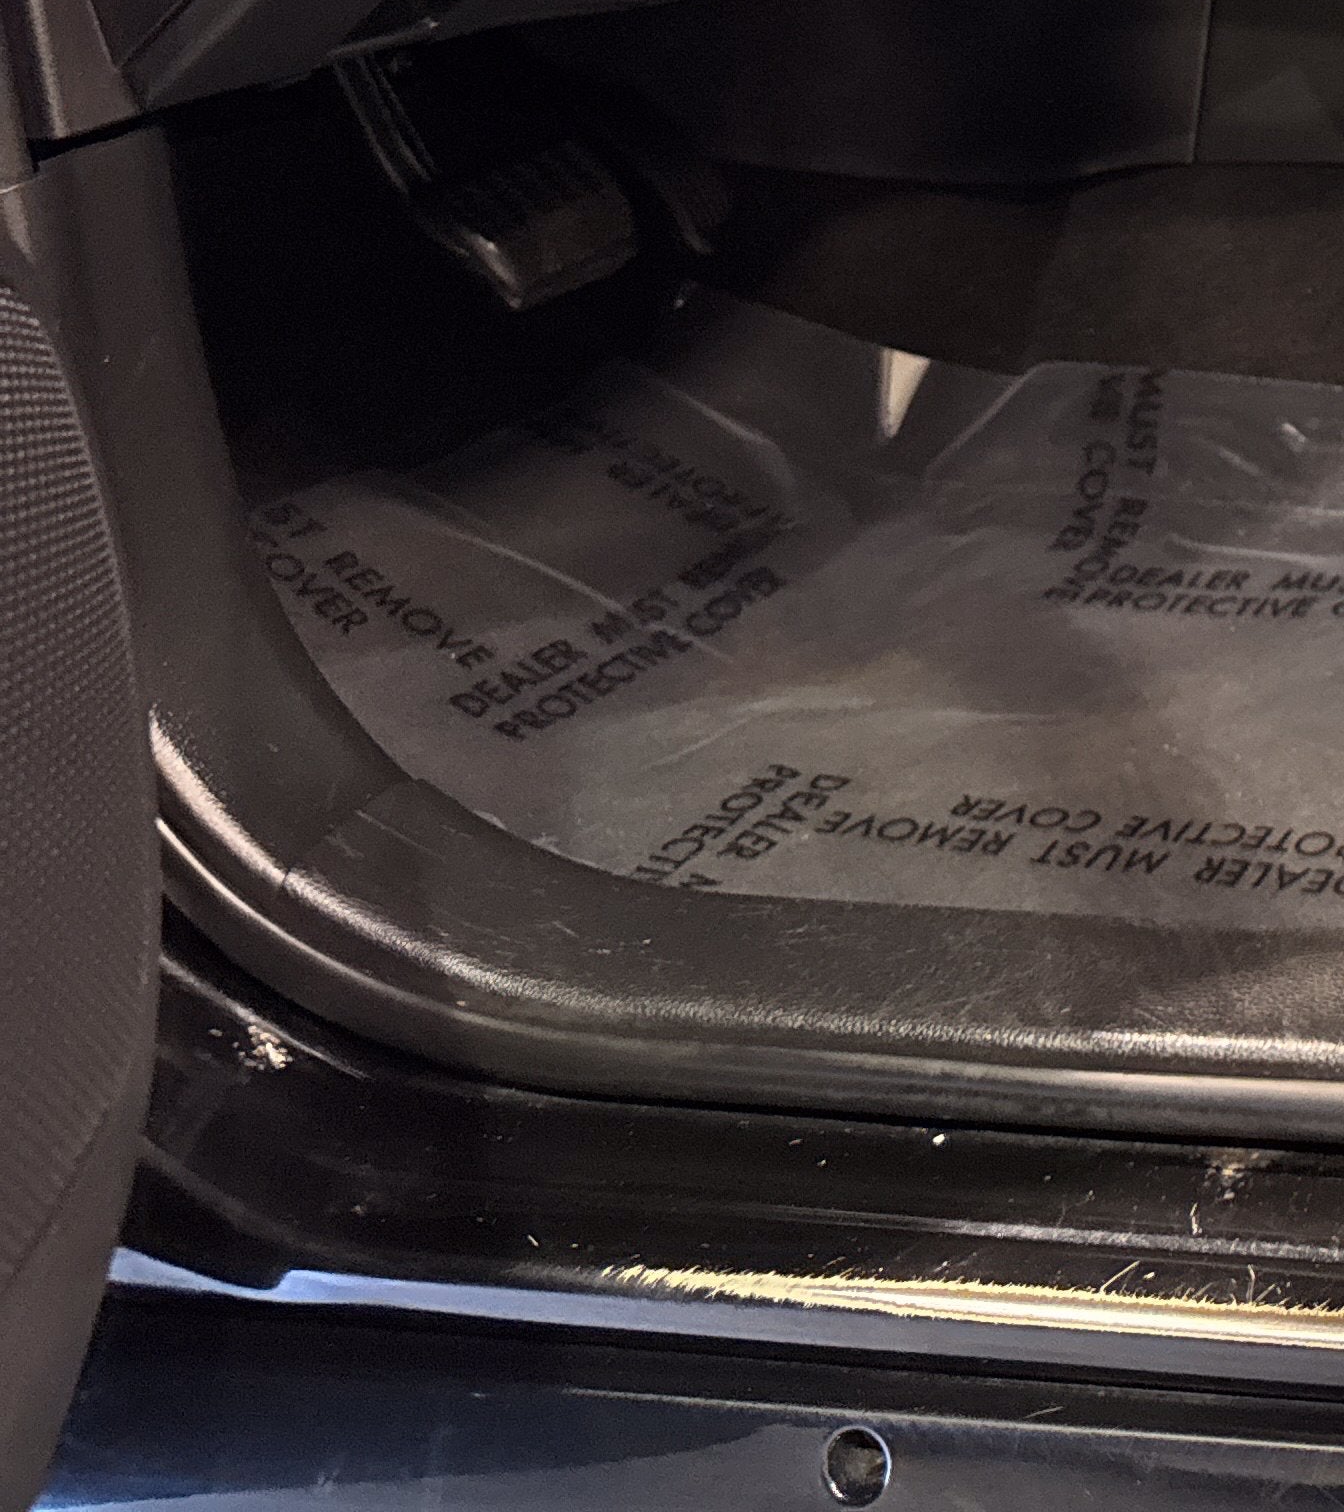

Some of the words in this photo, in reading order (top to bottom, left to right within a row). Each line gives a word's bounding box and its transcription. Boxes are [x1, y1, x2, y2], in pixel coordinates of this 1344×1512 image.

[323, 549, 497, 672] REMOVE
[448, 638, 590, 719] DEALER
[716, 773, 852, 860] DEALER
[813, 809, 1015, 856] REMOVE
[947, 792, 1102, 833] COVER
[1030, 837, 1171, 875] MUST
